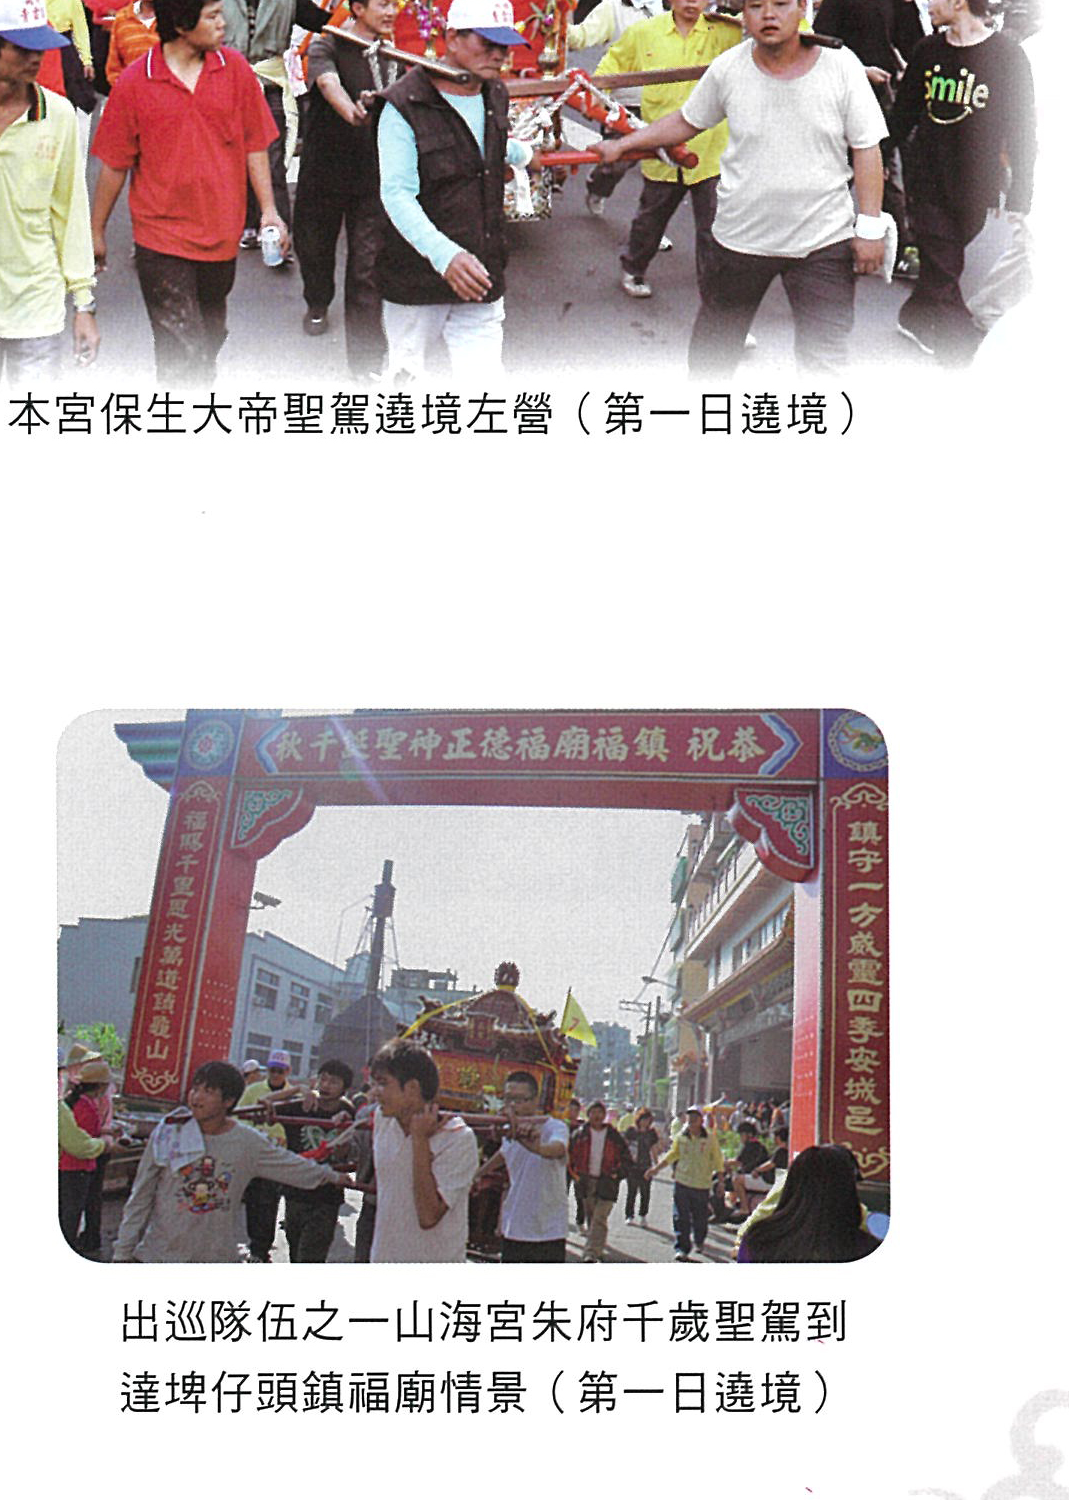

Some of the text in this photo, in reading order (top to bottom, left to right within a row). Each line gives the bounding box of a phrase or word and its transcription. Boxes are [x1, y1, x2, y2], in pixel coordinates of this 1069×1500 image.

[687, 726, 765, 763] 恭祝
[844, 820, 883, 1136] 鎮守一方威靈四季安城邑
